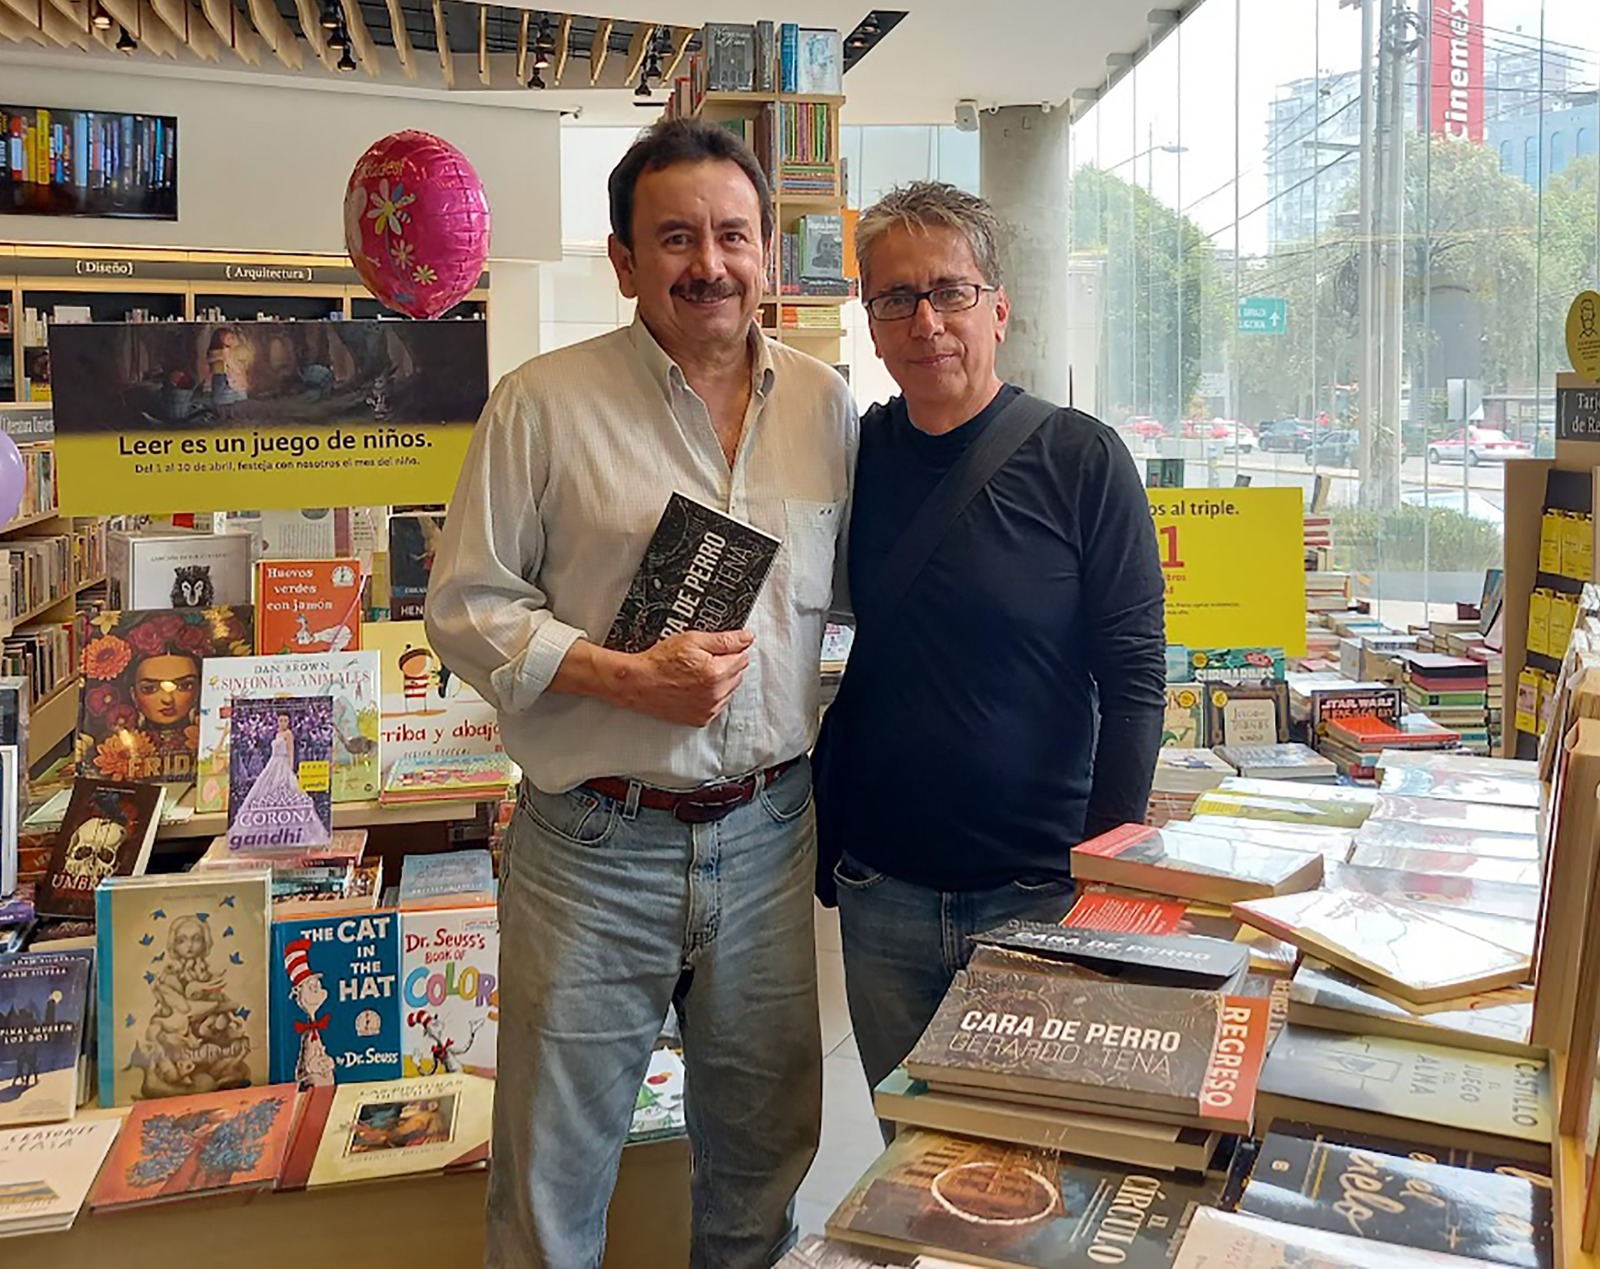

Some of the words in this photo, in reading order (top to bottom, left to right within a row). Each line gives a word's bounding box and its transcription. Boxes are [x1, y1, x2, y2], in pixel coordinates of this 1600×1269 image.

[1572, 415, 1584, 433] de
[119, 435, 173, 455] Leer
[181, 438, 207, 454] es
[215, 437, 246, 453] un
[251, 431, 320, 458] juego
[327, 429, 356, 450] de
[364, 427, 432, 449] niños.
[135, 464, 153, 473] Del
[165, 463, 174, 472] al
[194, 462, 206, 472] de
[209, 461, 236, 473] abril,
[237, 460, 273, 472] festeja
[275, 461, 294, 469] con
[296, 459, 340, 469] nosotros
[342, 458, 352, 467] el
[1171, 500, 1185, 516] al
[1190, 500, 1240, 519] triple.
[266, 567, 314, 579] Huevos
[684, 531, 726, 593] PERRO
[713, 546, 752, 591] TENA
[273, 582, 317, 595] verdes
[266, 601, 291, 612] con
[292, 598, 333, 613] jamón
[671, 588, 700, 619] DE
[253, 663, 281, 674] DAN
[283, 661, 331, 673] BROWN
[220, 674, 285, 691] SINFONÍA
[295, 670, 372, 688] ANIMALES
[1321, 699, 1358, 709] STAR
[1358, 697, 1394, 708] WARS
[432, 727, 445, 745] y
[239, 809, 319, 827] CORONA
[229, 827, 303, 850] gandhi
[300, 927, 334, 942] THE
[337, 917, 391, 943] CAT
[405, 933, 430, 953] Dr.
[433, 927, 486, 949] Seuss's
[357, 944, 376, 958] IN
[424, 951, 453, 965] BOOK
[453, 949, 466, 961] OF
[1014, 931, 1080, 946] CARA
[1084, 939, 1123, 951] DE
[1125, 943, 1212, 961] PERRO
[350, 961, 382, 975] THE
[339, 974, 396, 1002] HAT
[960, 1009, 1036, 1037] CARA
[1040, 1018, 1081, 1042] DE
[1084, 1023, 1182, 1053] PERRO
[345, 1051, 365, 1068] Dr.
[366, 1047, 399, 1064] Seuss
[948, 1032, 1081, 1065] GERARDO
[1100, 1046, 1172, 1078] TENA
[1203, 1006, 1252, 1108] REGRESO
[1408, 1054, 1441, 1095] ALMA
[1459, 1064, 1484, 1104] JUEGO
[1511, 1062, 1540, 1127] CASTILLO
[1087, 1174, 1167, 1265] CÍRCULO
[1146, 1214, 1169, 1229] EL
